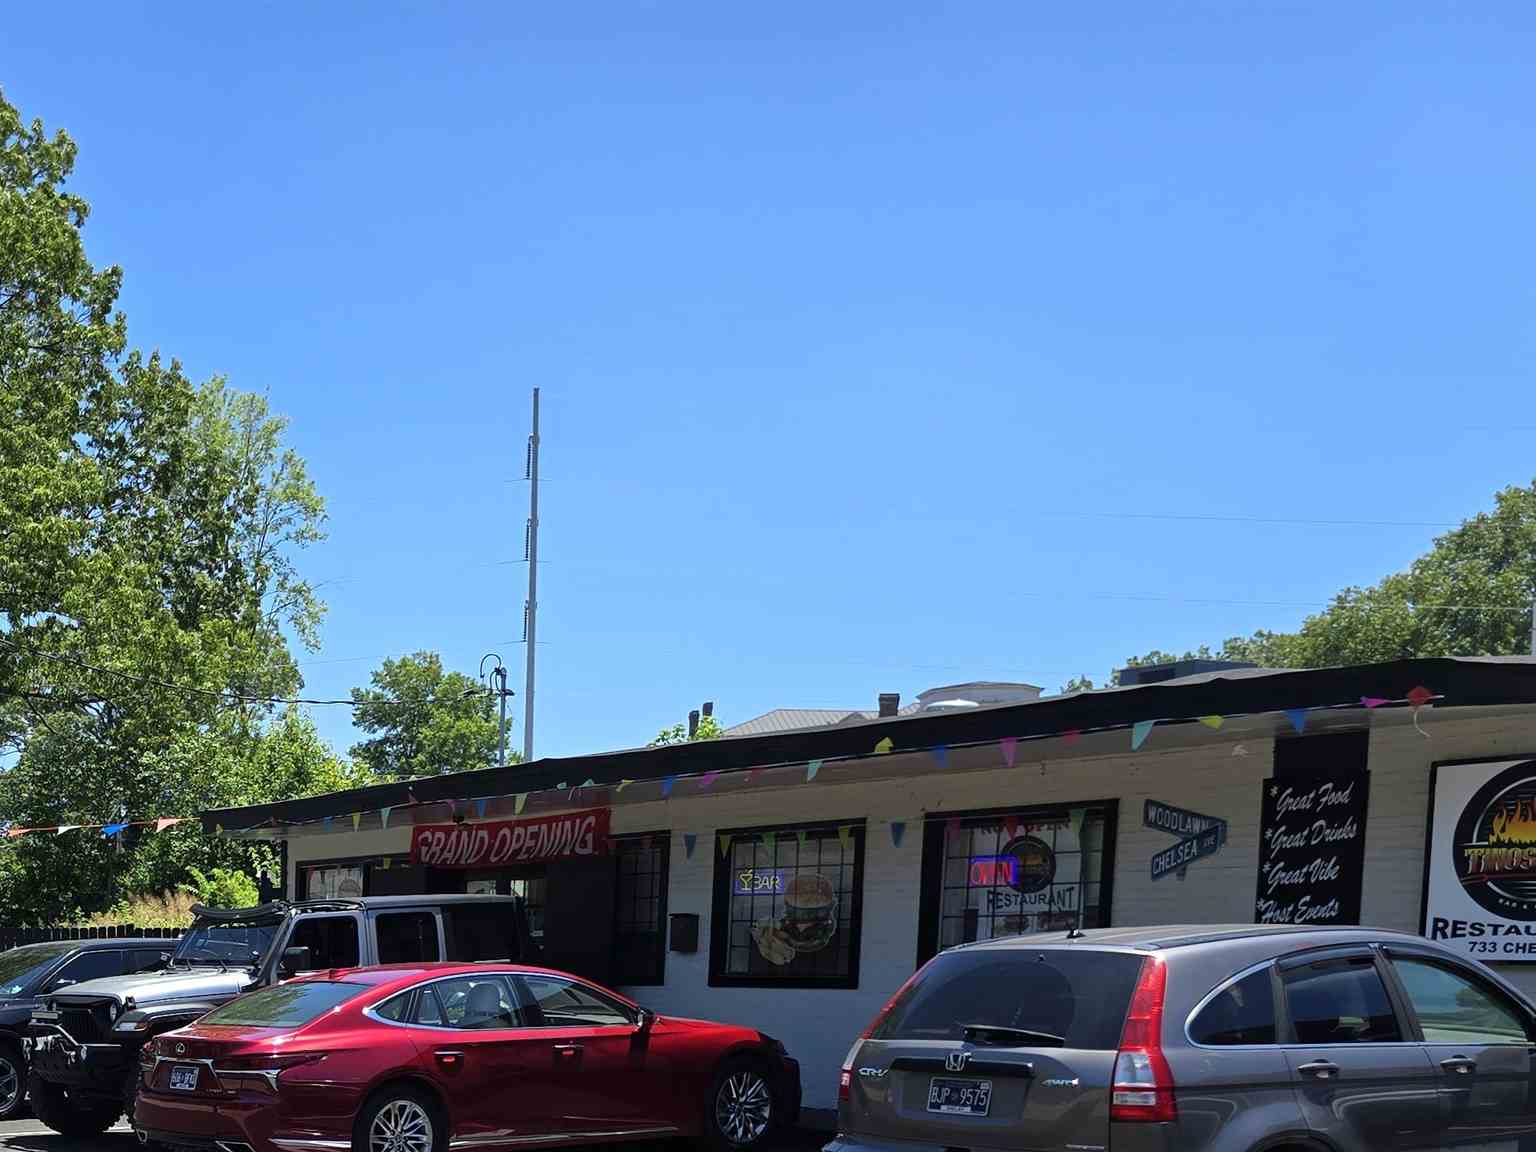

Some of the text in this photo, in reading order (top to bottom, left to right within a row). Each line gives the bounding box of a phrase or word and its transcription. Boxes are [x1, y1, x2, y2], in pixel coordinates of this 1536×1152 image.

[1275, 781, 1354, 821] Great Food
[1148, 806, 1210, 833] WOODLAWN
[418, 816, 596, 864] GRAND OPENING
[1270, 816, 1358, 859] Great Drinks
[1152, 839, 1198, 875] CHELSEA
[1267, 856, 1340, 895] Great Vibe
[987, 887, 1075, 912] RESTAURANT
[1261, 895, 1339, 924] Host Events
[1431, 917, 1536, 941] RESTAU
[1468, 942, 1536, 954] 733 CHE
[930, 1087, 988, 1106] BJP 9575
